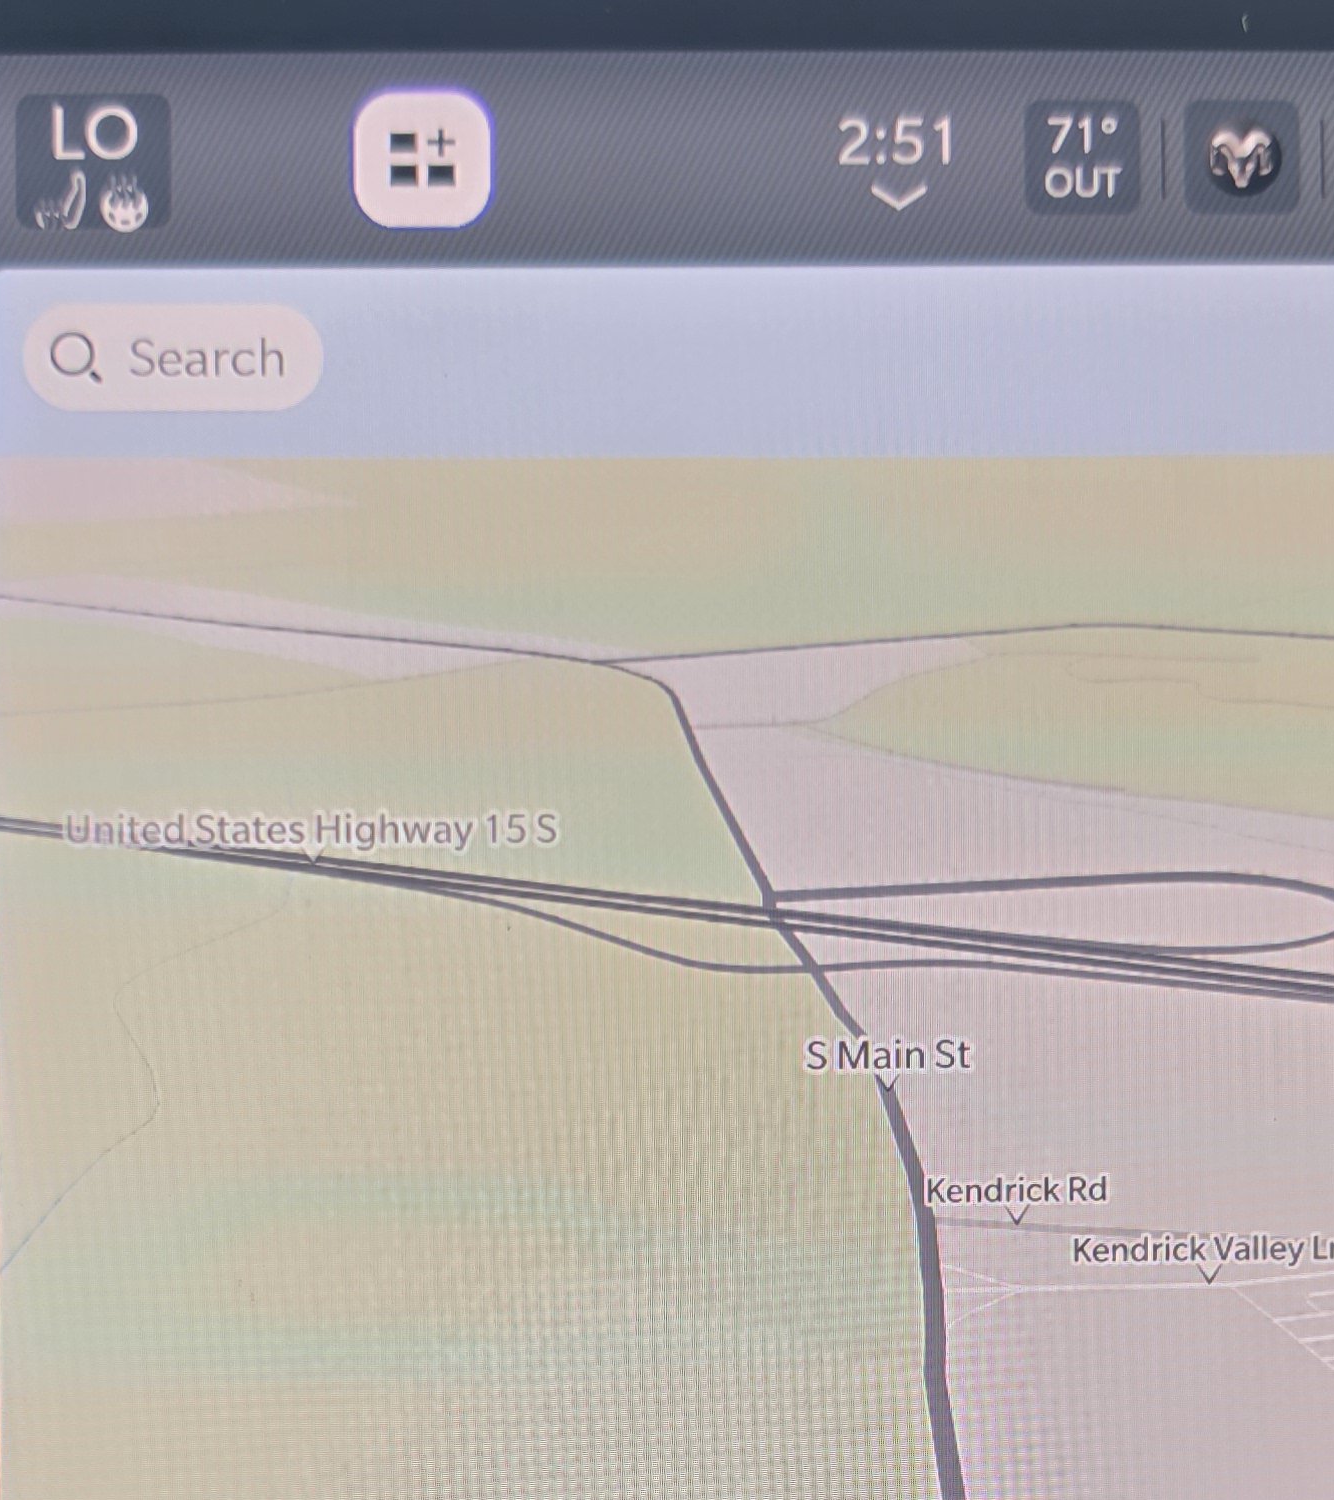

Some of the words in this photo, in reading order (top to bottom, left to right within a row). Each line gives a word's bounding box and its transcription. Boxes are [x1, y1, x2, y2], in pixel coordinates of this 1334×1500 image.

[50, 104, 140, 161] LO
[838, 113, 956, 165] 2:51
[1046, 115, 1118, 154] 71°
[1044, 165, 1122, 199] OUT
[128, 334, 287, 379] Search
[66, 812, 195, 845] United
[197, 812, 303, 845] States
[316, 812, 473, 850] Highway
[486, 812, 526, 845] 15
[536, 812, 558, 845] S
[805, 1040, 828, 1070] S
[837, 1040, 925, 1070] Main
[934, 1039, 971, 1069] St
[926, 1175, 1060, 1203] Kendrick
[1068, 1176, 1108, 1202] Rd
[1072, 1235, 1206, 1263] Kendrick
[1213, 1236, 1304, 1267] Valley
